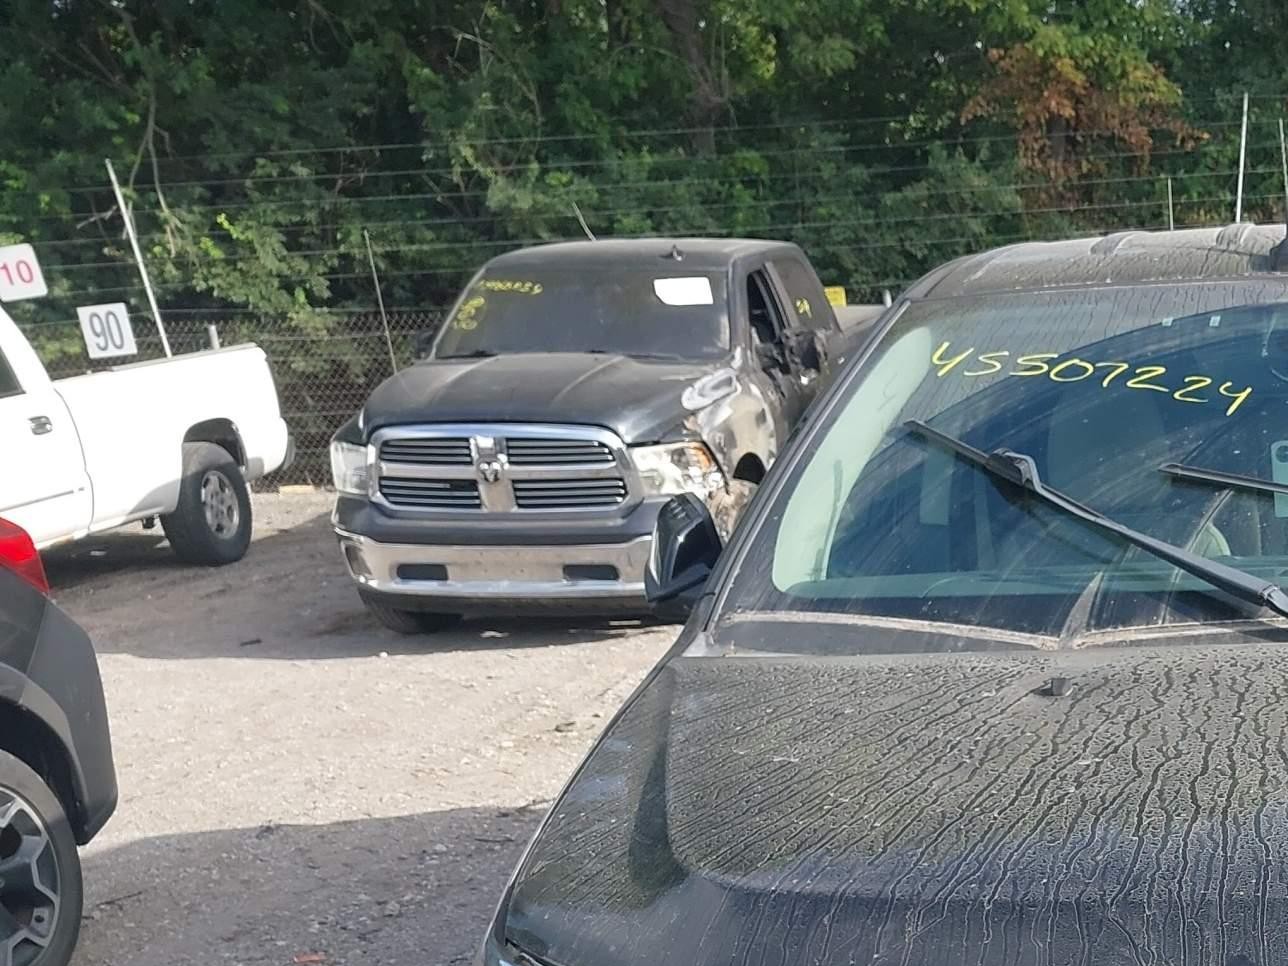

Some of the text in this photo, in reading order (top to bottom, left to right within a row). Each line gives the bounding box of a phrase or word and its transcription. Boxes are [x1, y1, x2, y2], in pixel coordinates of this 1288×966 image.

[0, 260, 34, 285] 10
[89, 311, 124, 351] 90
[931, 341, 1252, 417] 45507224
